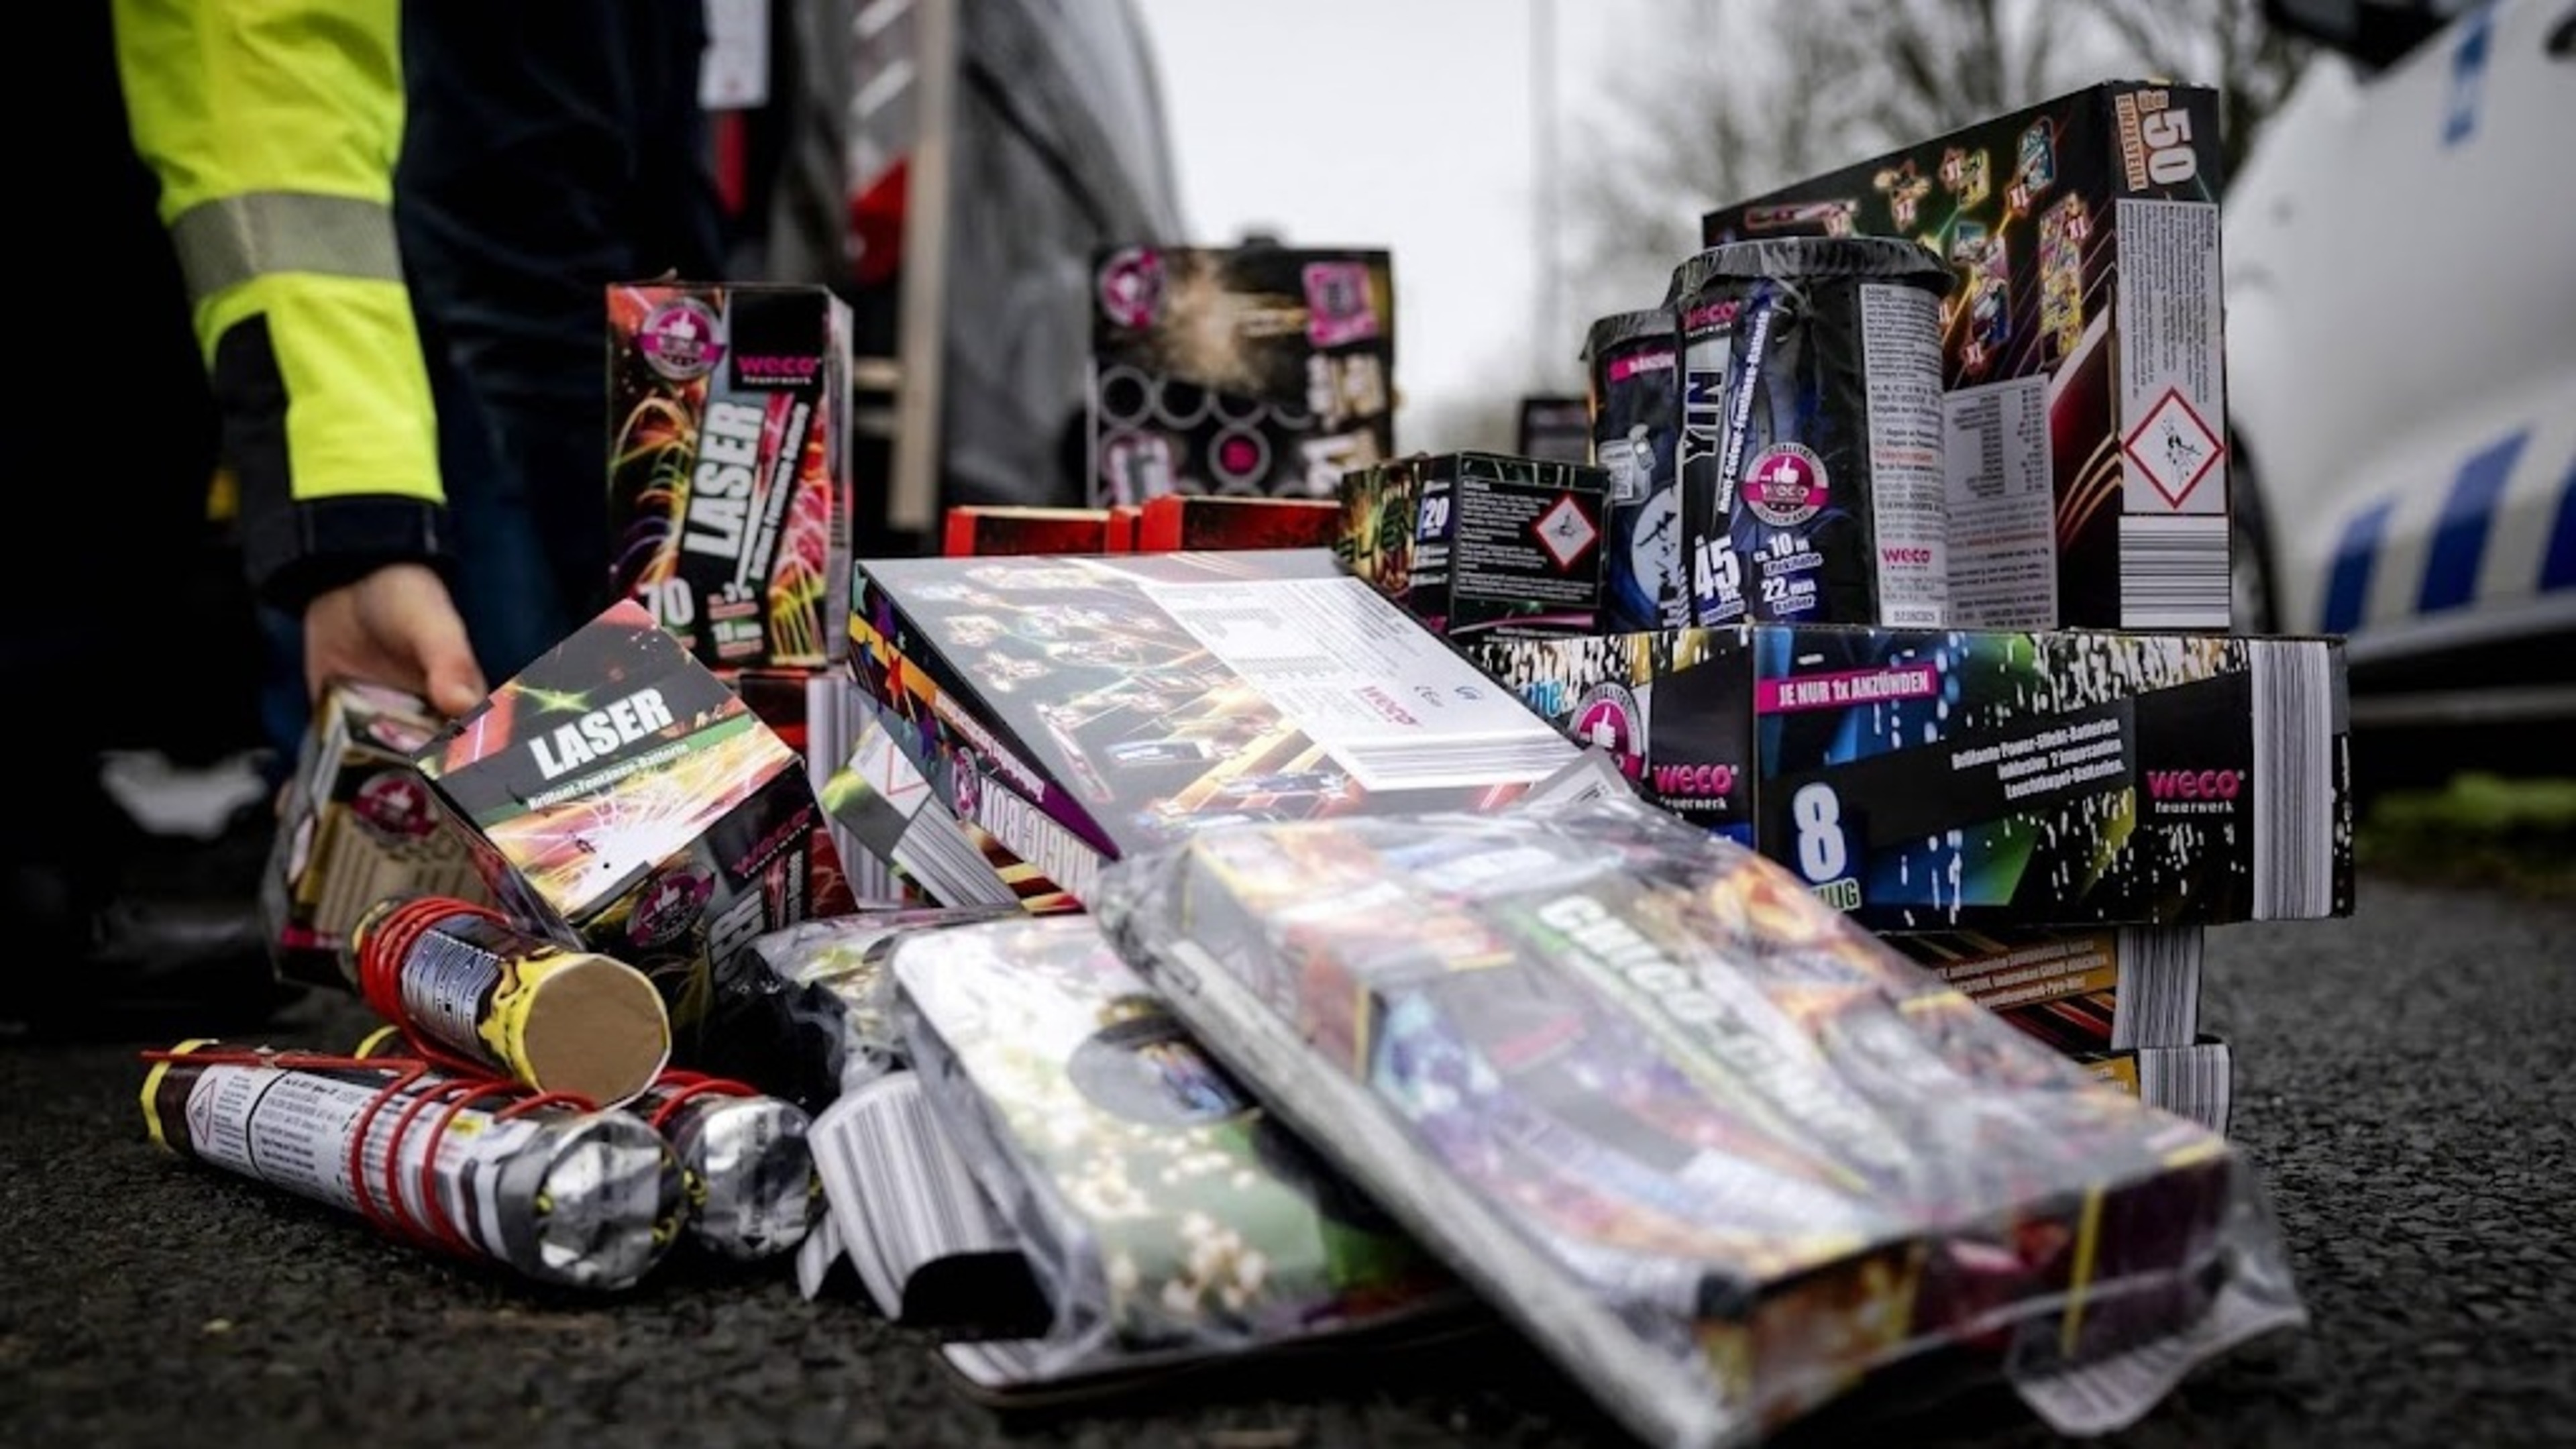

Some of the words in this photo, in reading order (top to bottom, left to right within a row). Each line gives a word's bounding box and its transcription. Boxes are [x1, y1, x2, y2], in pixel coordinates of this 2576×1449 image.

[2116, 94, 2147, 191] EINZELTEILE
[2143, 108, 2197, 184] 50
[738, 356, 816, 375] weco
[1682, 370, 1725, 463] YIN
[684, 402, 764, 559] LASER
[1423, 496, 1450, 529] 20
[1768, 533, 1794, 557] 10
[1882, 547, 1931, 564] weco
[1695, 535, 1741, 600] 45
[1761, 576, 1788, 602] 22
[1779, 684, 1795, 706] JE
[1796, 681, 1830, 704] NUR
[1831, 679, 1849, 700] 1x
[1850, 669, 1929, 699] ANZÜNDEN
[528, 688, 674, 781] LASER
[1653, 764, 1732, 794] weco
[2146, 769, 2239, 798] weco
[980, 776, 1020, 858] BOX
[2155, 800, 2235, 813] feuerwerk
[1793, 782, 1847, 883] 8
